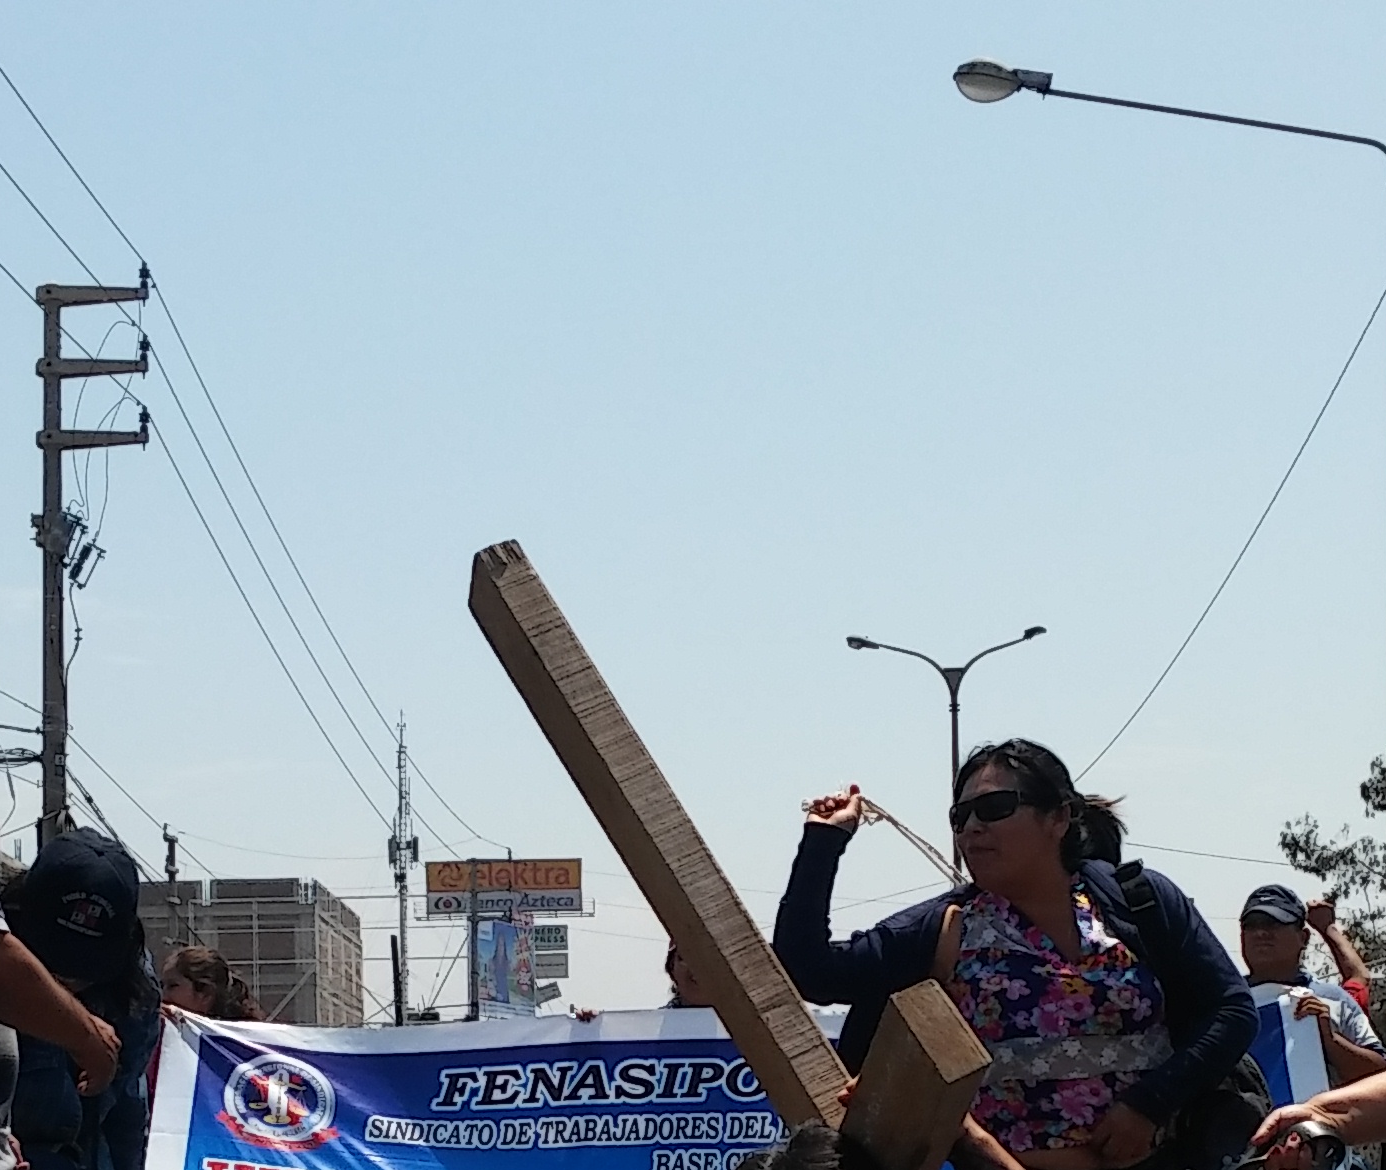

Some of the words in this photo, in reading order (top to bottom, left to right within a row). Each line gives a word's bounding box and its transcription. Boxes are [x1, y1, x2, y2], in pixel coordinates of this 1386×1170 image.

[476, 863, 569, 887] elektra
[518, 893, 574, 908] Azteca
[368, 1118, 494, 1146] SINDICATO
[501, 1122, 533, 1146] DE
[539, 1117, 720, 1145] TRABAJADORES
[728, 1116, 773, 1140] DEL
